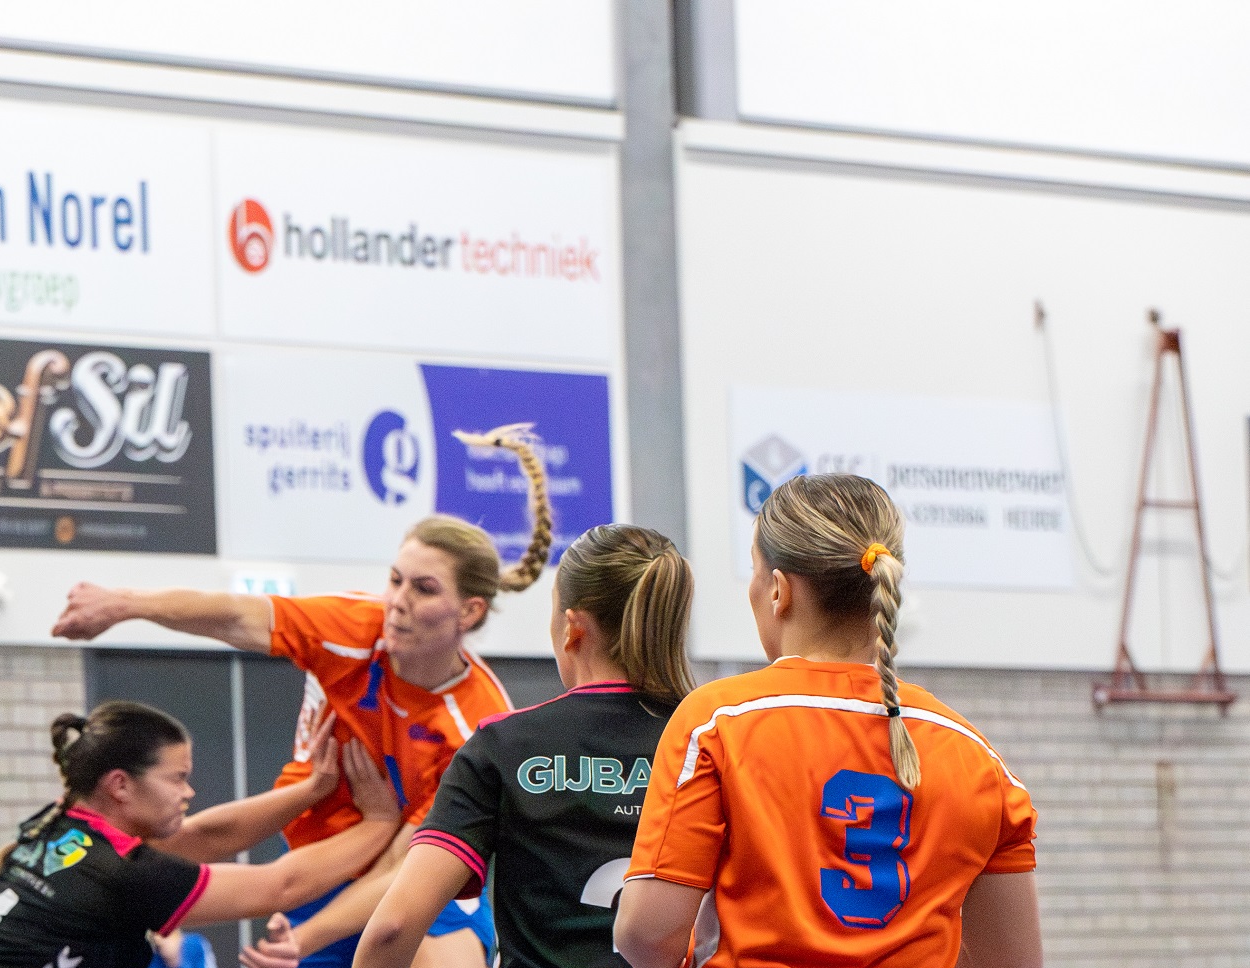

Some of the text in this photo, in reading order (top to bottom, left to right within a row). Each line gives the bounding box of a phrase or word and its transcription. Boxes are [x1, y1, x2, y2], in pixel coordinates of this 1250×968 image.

[27, 168, 150, 255] Norel
[282, 211, 602, 284] hollander techniek
[517, 755, 652, 795] GIJBA
[819, 768, 914, 930] 3
